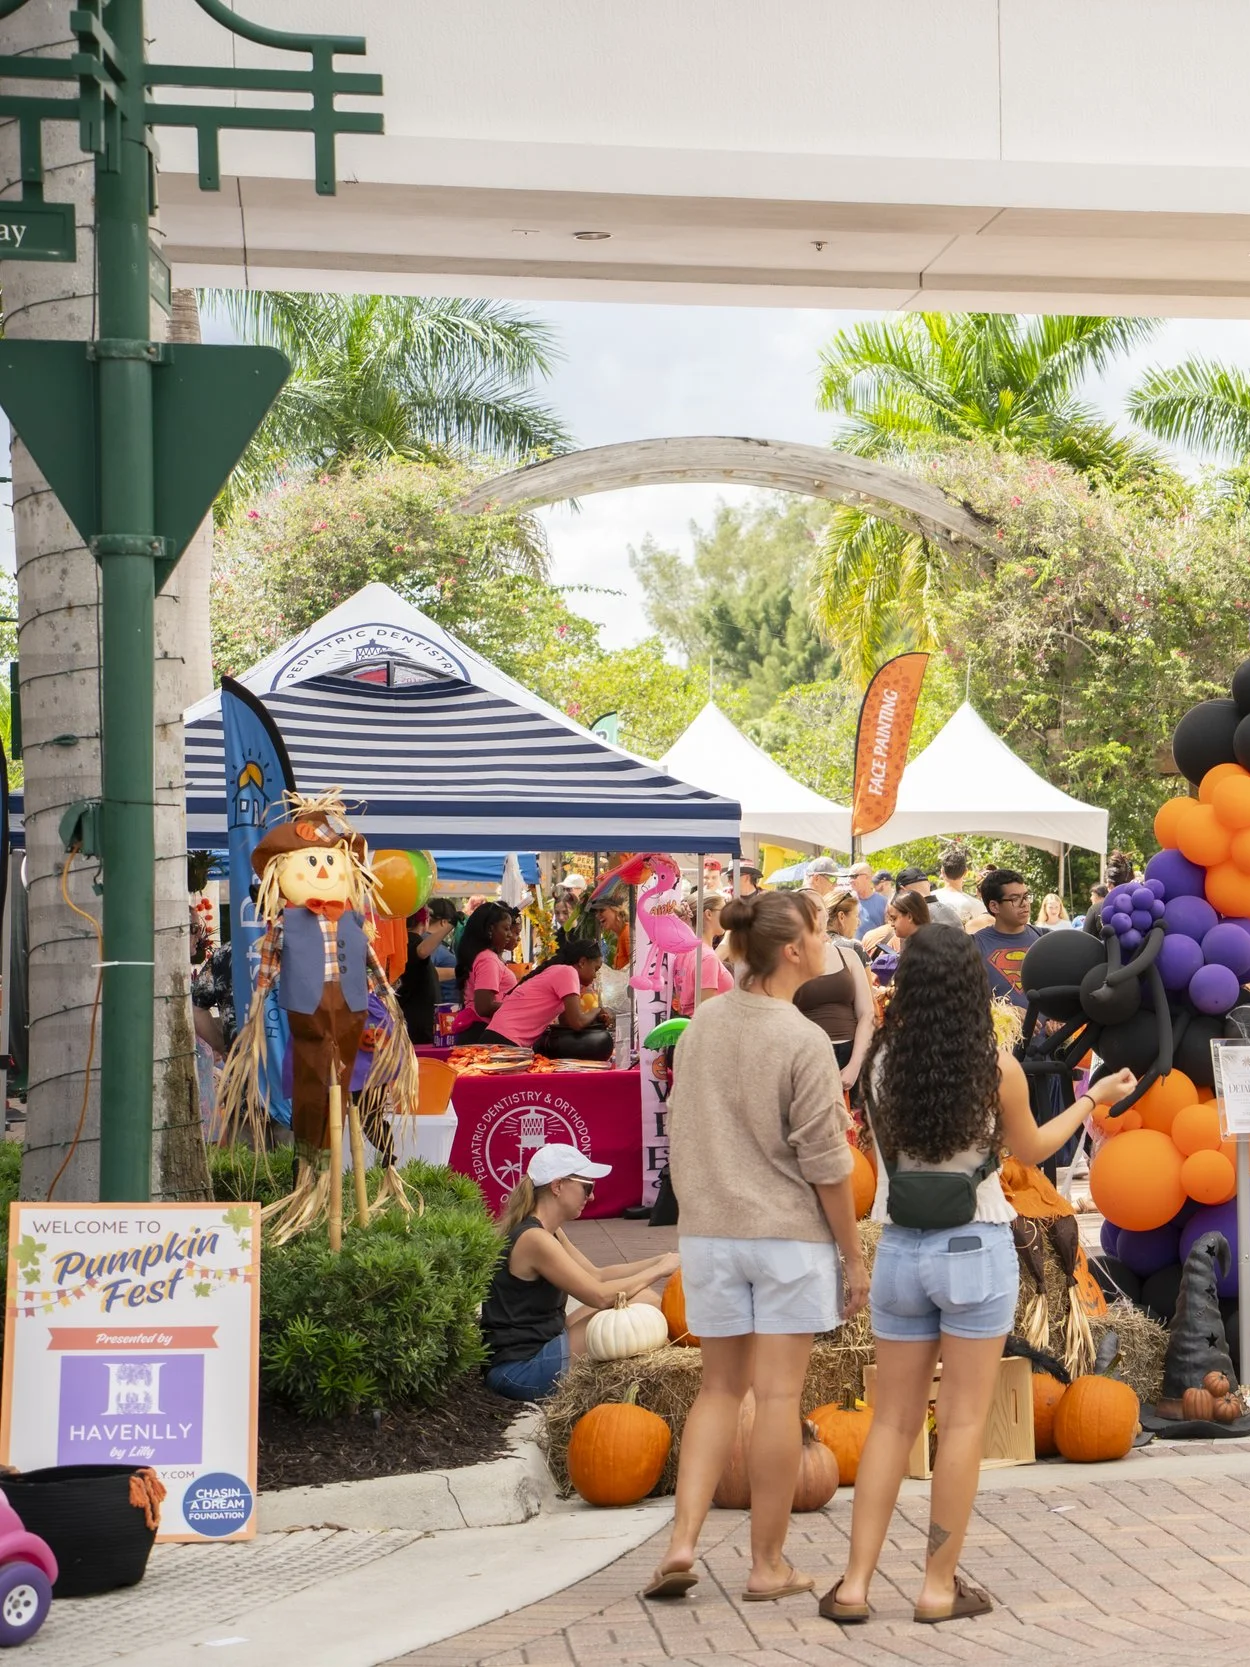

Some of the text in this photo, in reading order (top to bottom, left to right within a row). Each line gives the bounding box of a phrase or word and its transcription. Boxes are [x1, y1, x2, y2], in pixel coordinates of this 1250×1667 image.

[286, 629, 458, 680] PEDIATRIC DENTISTRY
[868, 689, 899, 796] FACE PAINTING
[267, 988, 279, 1039] HOM
[471, 1091, 592, 1181] PEDIATRIC DENTISTRY & ORTHODONT
[33, 1220, 161, 1234] WELCOME TO
[53, 1226, 220, 1286] Pumpkin
[101, 1267, 184, 1313] Fest
[96, 1333, 173, 1346] Presented by
[69, 1422, 193, 1441] HAVENLLY
[109, 1445, 155, 1460] by Lilly
[156, 1470, 195, 1479] Y.COM
[195, 1488, 241, 1499] CHASIN
[190, 1499, 245, 1509] A DREAM
[188, 1512, 245, 1521] FOUNDATION
